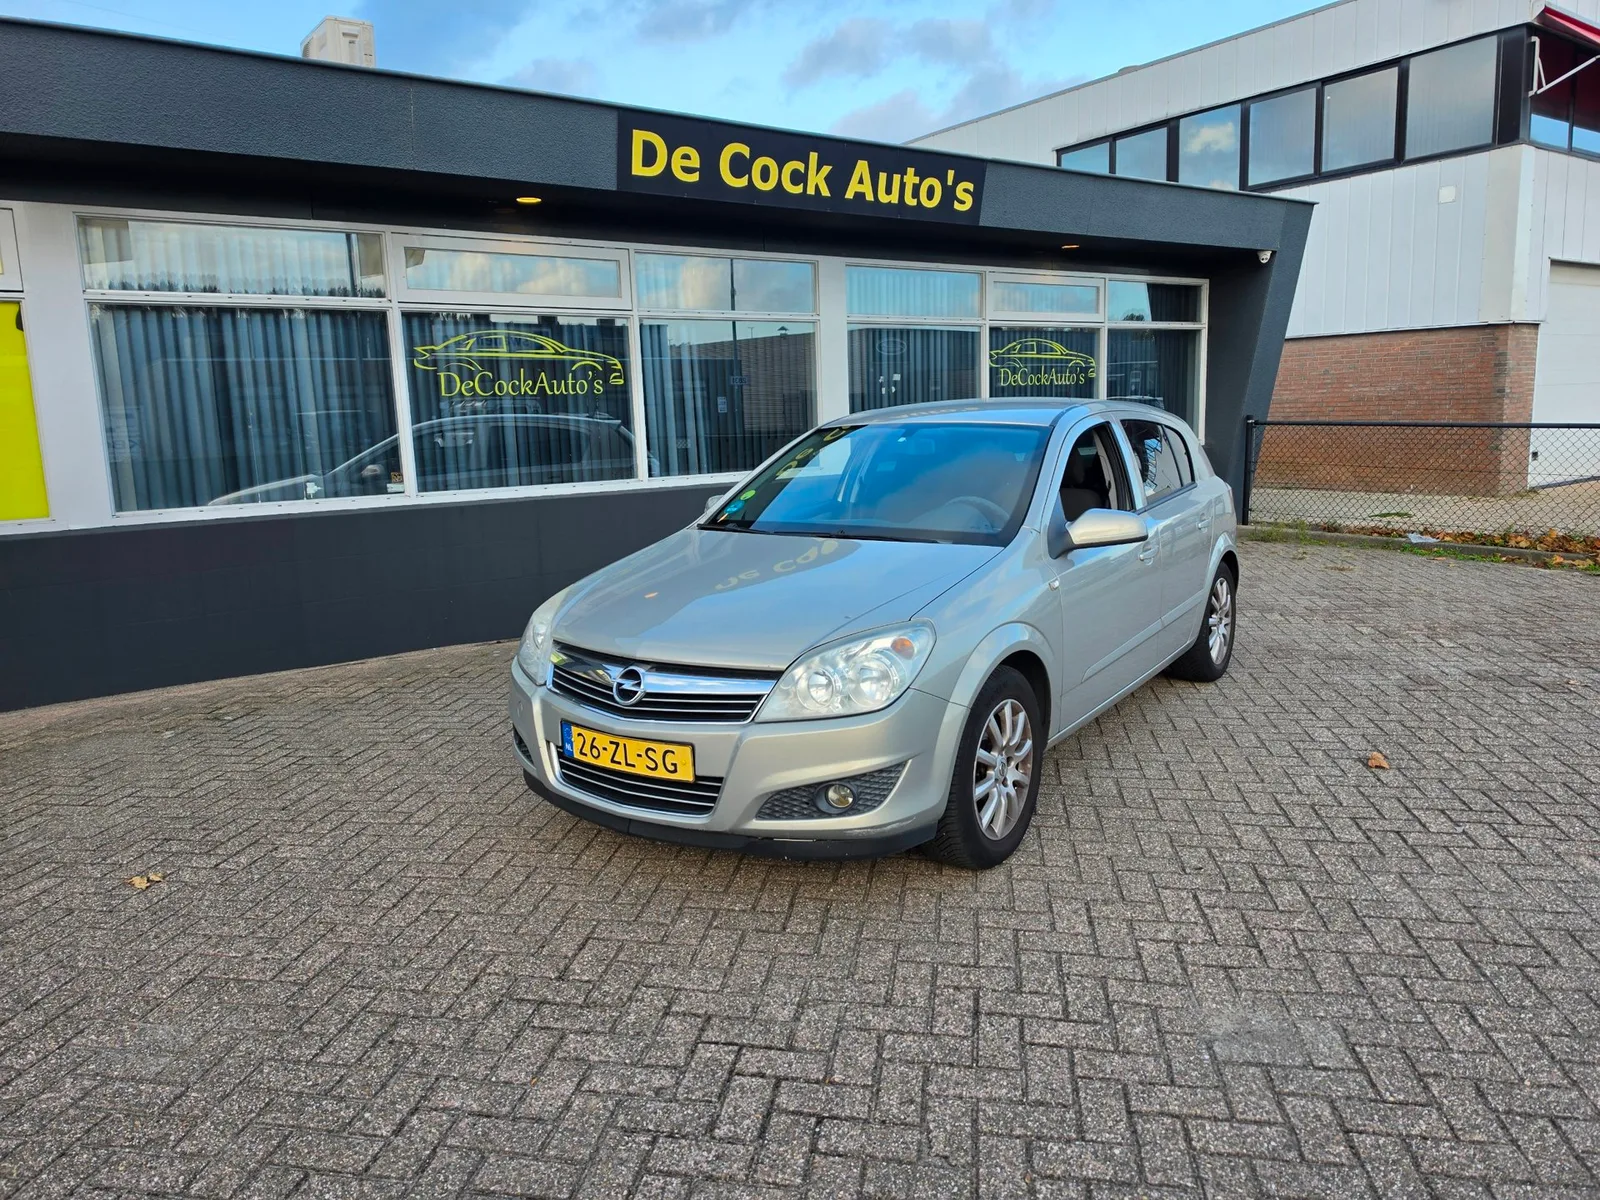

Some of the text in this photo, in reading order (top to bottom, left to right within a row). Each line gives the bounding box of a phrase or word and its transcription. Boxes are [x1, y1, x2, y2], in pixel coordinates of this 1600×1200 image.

[631, 129, 974, 212] De Cock Auto's
[437, 368, 604, 397] DeCockAuto's
[999, 364, 1085, 387] DeCockAuto's
[565, 742, 573, 752] NL
[576, 732, 679, 774] 26-ZL-SG
